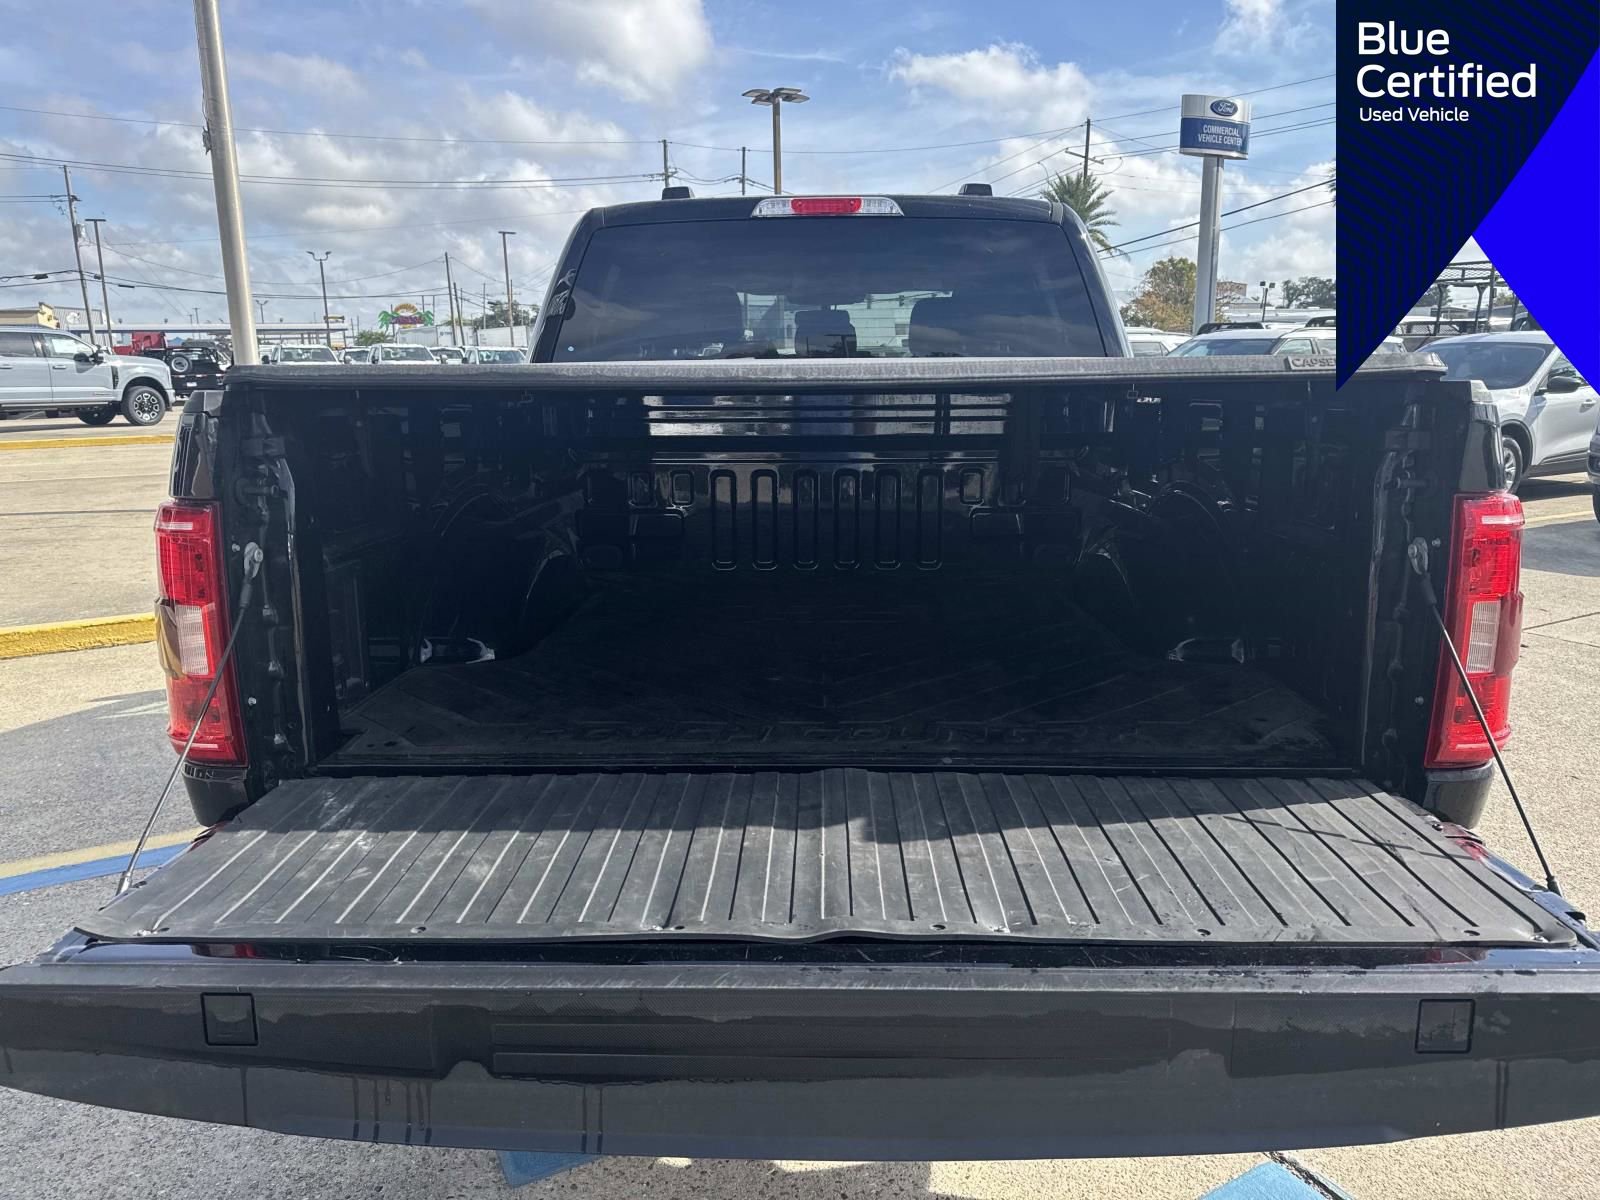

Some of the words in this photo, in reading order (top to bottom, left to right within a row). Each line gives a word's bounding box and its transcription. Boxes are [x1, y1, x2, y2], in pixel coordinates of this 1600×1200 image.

[1217, 102, 1236, 114] Ford
[1203, 124, 1240, 137] COMMERCIAL
[1198, 134, 1223, 144] VEHICLE
[1223, 136, 1243, 146] CENTER
